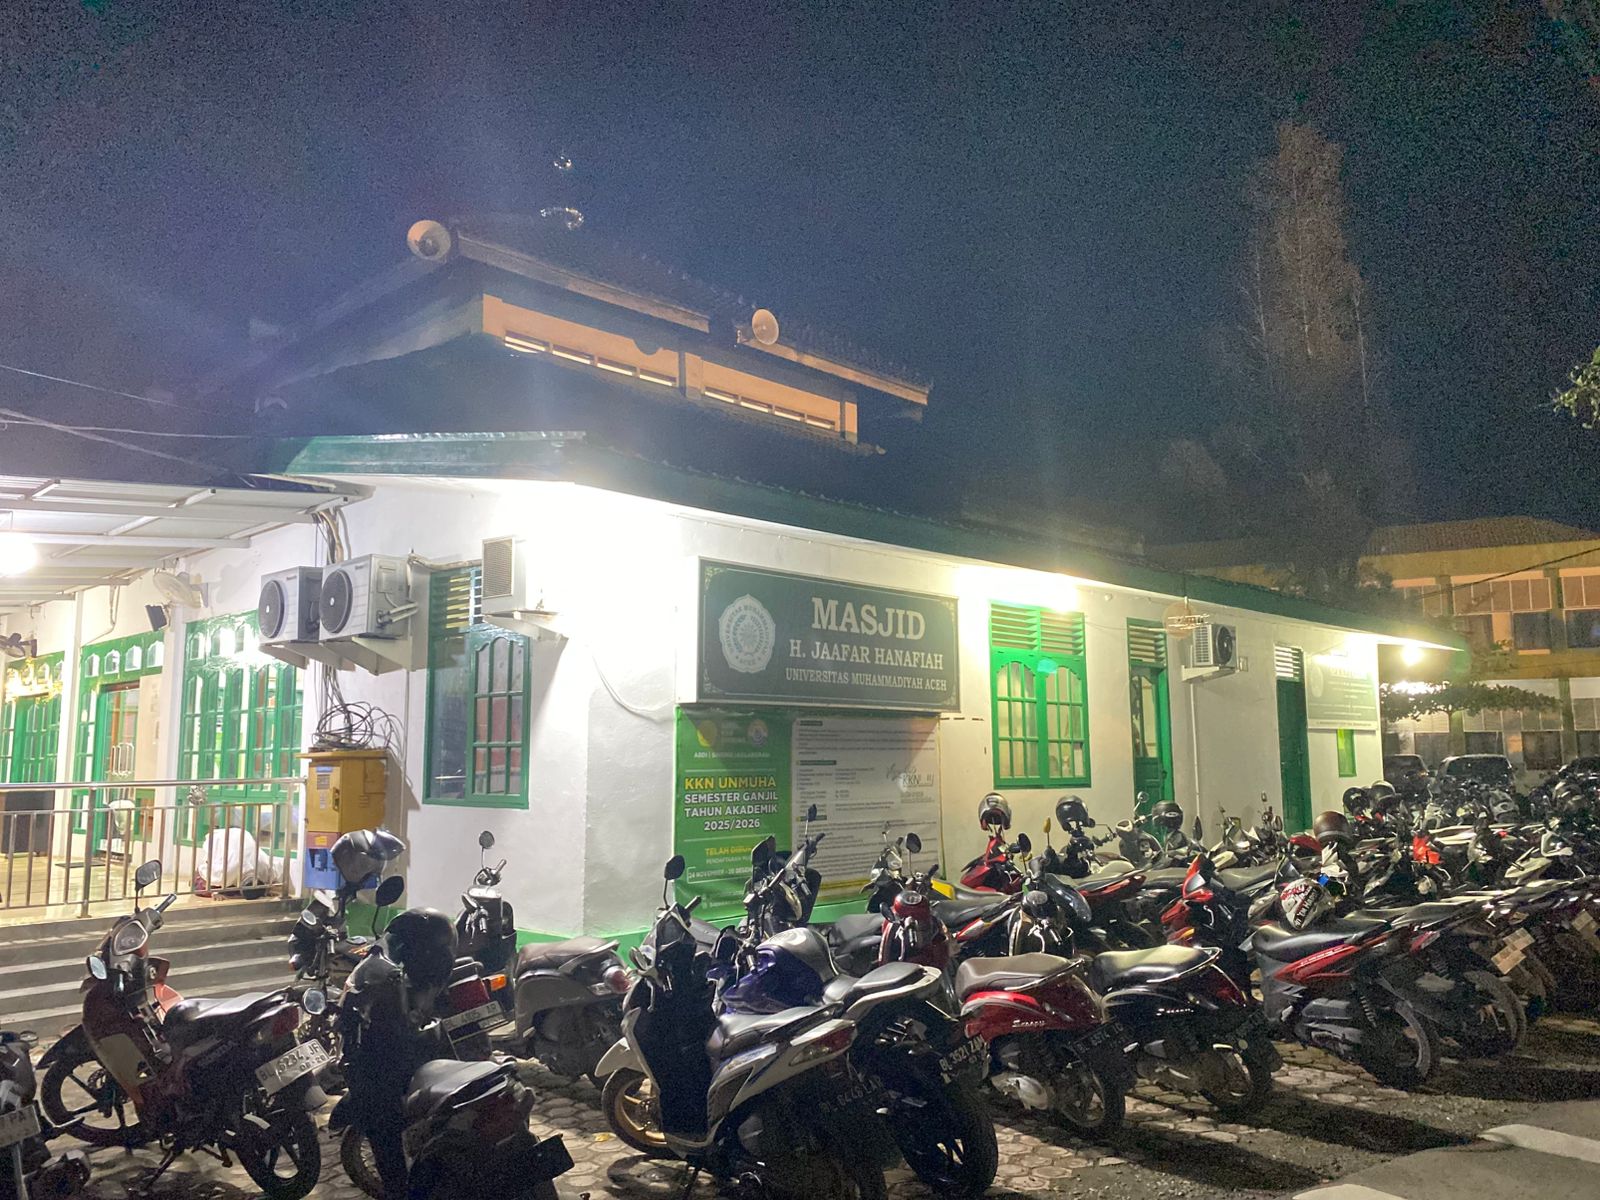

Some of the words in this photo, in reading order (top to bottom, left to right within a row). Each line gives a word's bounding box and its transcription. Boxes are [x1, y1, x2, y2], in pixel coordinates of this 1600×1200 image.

[811, 597, 926, 641] MASJID
[789, 639, 806, 659] H.
[811, 641, 870, 665] JAAFAR
[875, 647, 944, 671] HANAFIAH
[785, 667, 849, 685] UNIVERSITAS
[851, 672, 923, 691] MUHAMMADIYAH
[925, 677, 947, 692] ACEH
[685, 777, 714, 790] KKN
[719, 776, 776, 789] UNMUHA
[684, 792, 740, 804] SEMESTER
[743, 791, 778, 801] GANJIL
[684, 807, 722, 818] TAHUN
[725, 804, 778, 816] AKADEMIK
[704, 818, 761, 831] 2025/2026
[308, 1043, 319, 1055] JF
[939, 1057, 952, 1071] BL
